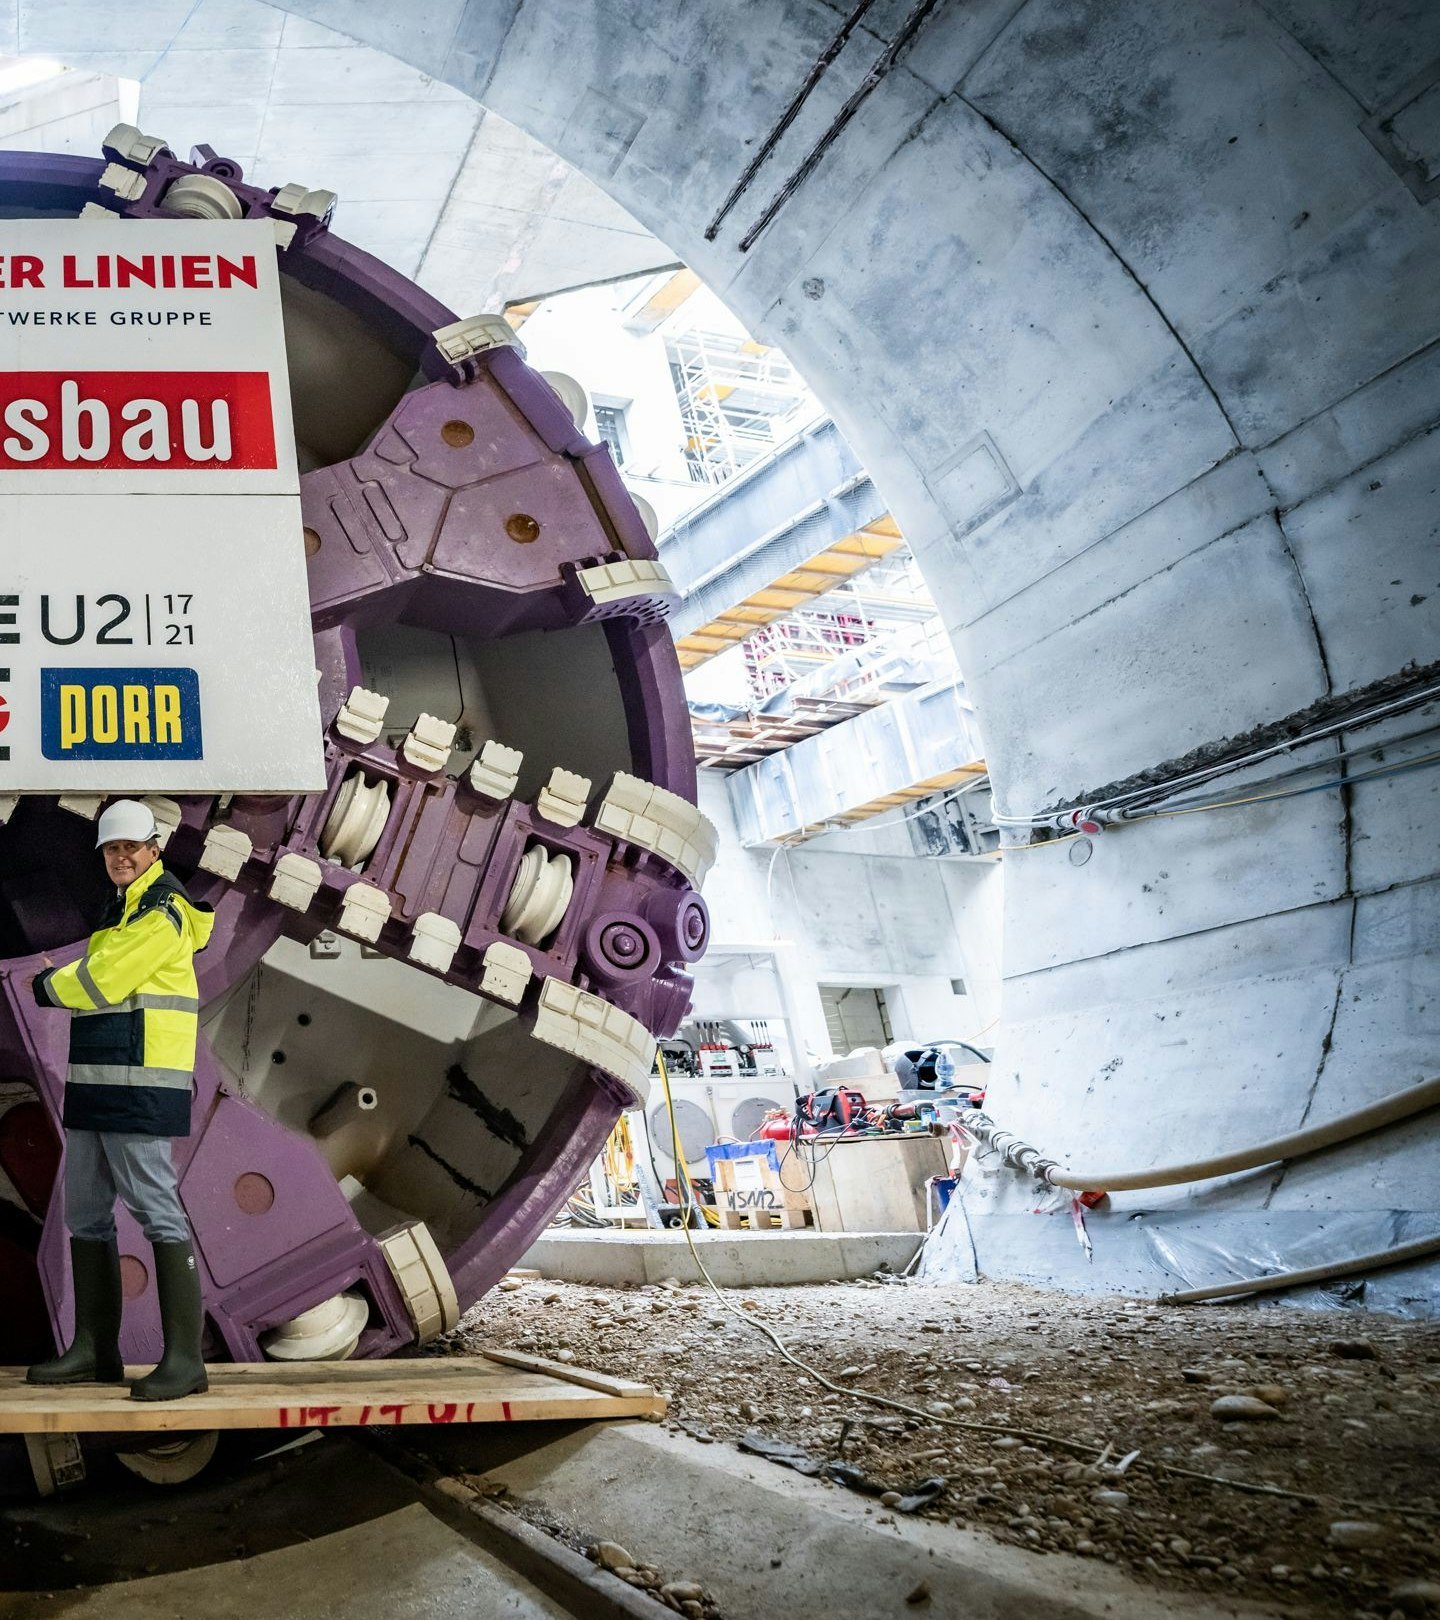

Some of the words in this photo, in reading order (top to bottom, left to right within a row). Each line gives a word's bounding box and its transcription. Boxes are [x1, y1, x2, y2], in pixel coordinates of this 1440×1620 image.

[63, 255, 258, 289] LINIEN
[110, 311, 213, 326] GRUPPE
[163, 594, 194, 615] 17
[40, 594, 133, 646] U2
[165, 624, 195, 645] 21
[60, 684, 183, 749] PORR
